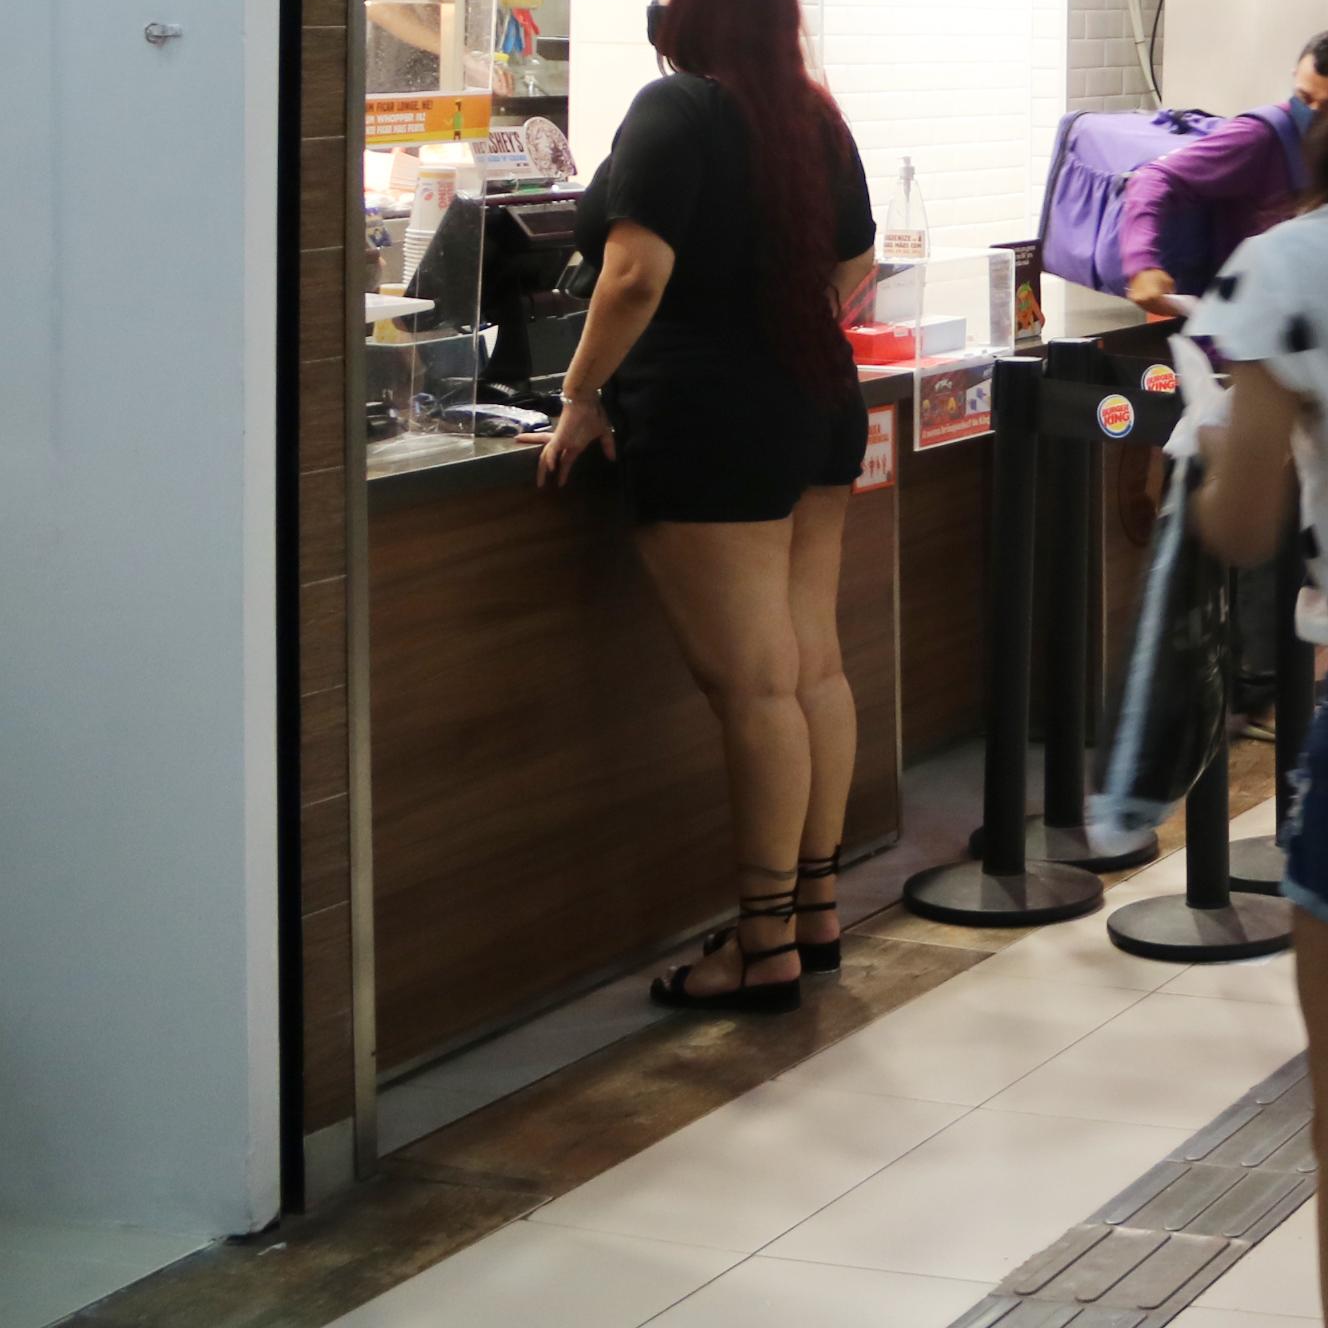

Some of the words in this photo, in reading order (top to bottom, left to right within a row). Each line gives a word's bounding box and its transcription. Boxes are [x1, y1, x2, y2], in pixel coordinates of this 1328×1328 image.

[1147, 373, 1175, 383] BURGER
[1102, 404, 1129, 415] BURGER
[1103, 412, 1130, 427] KING
